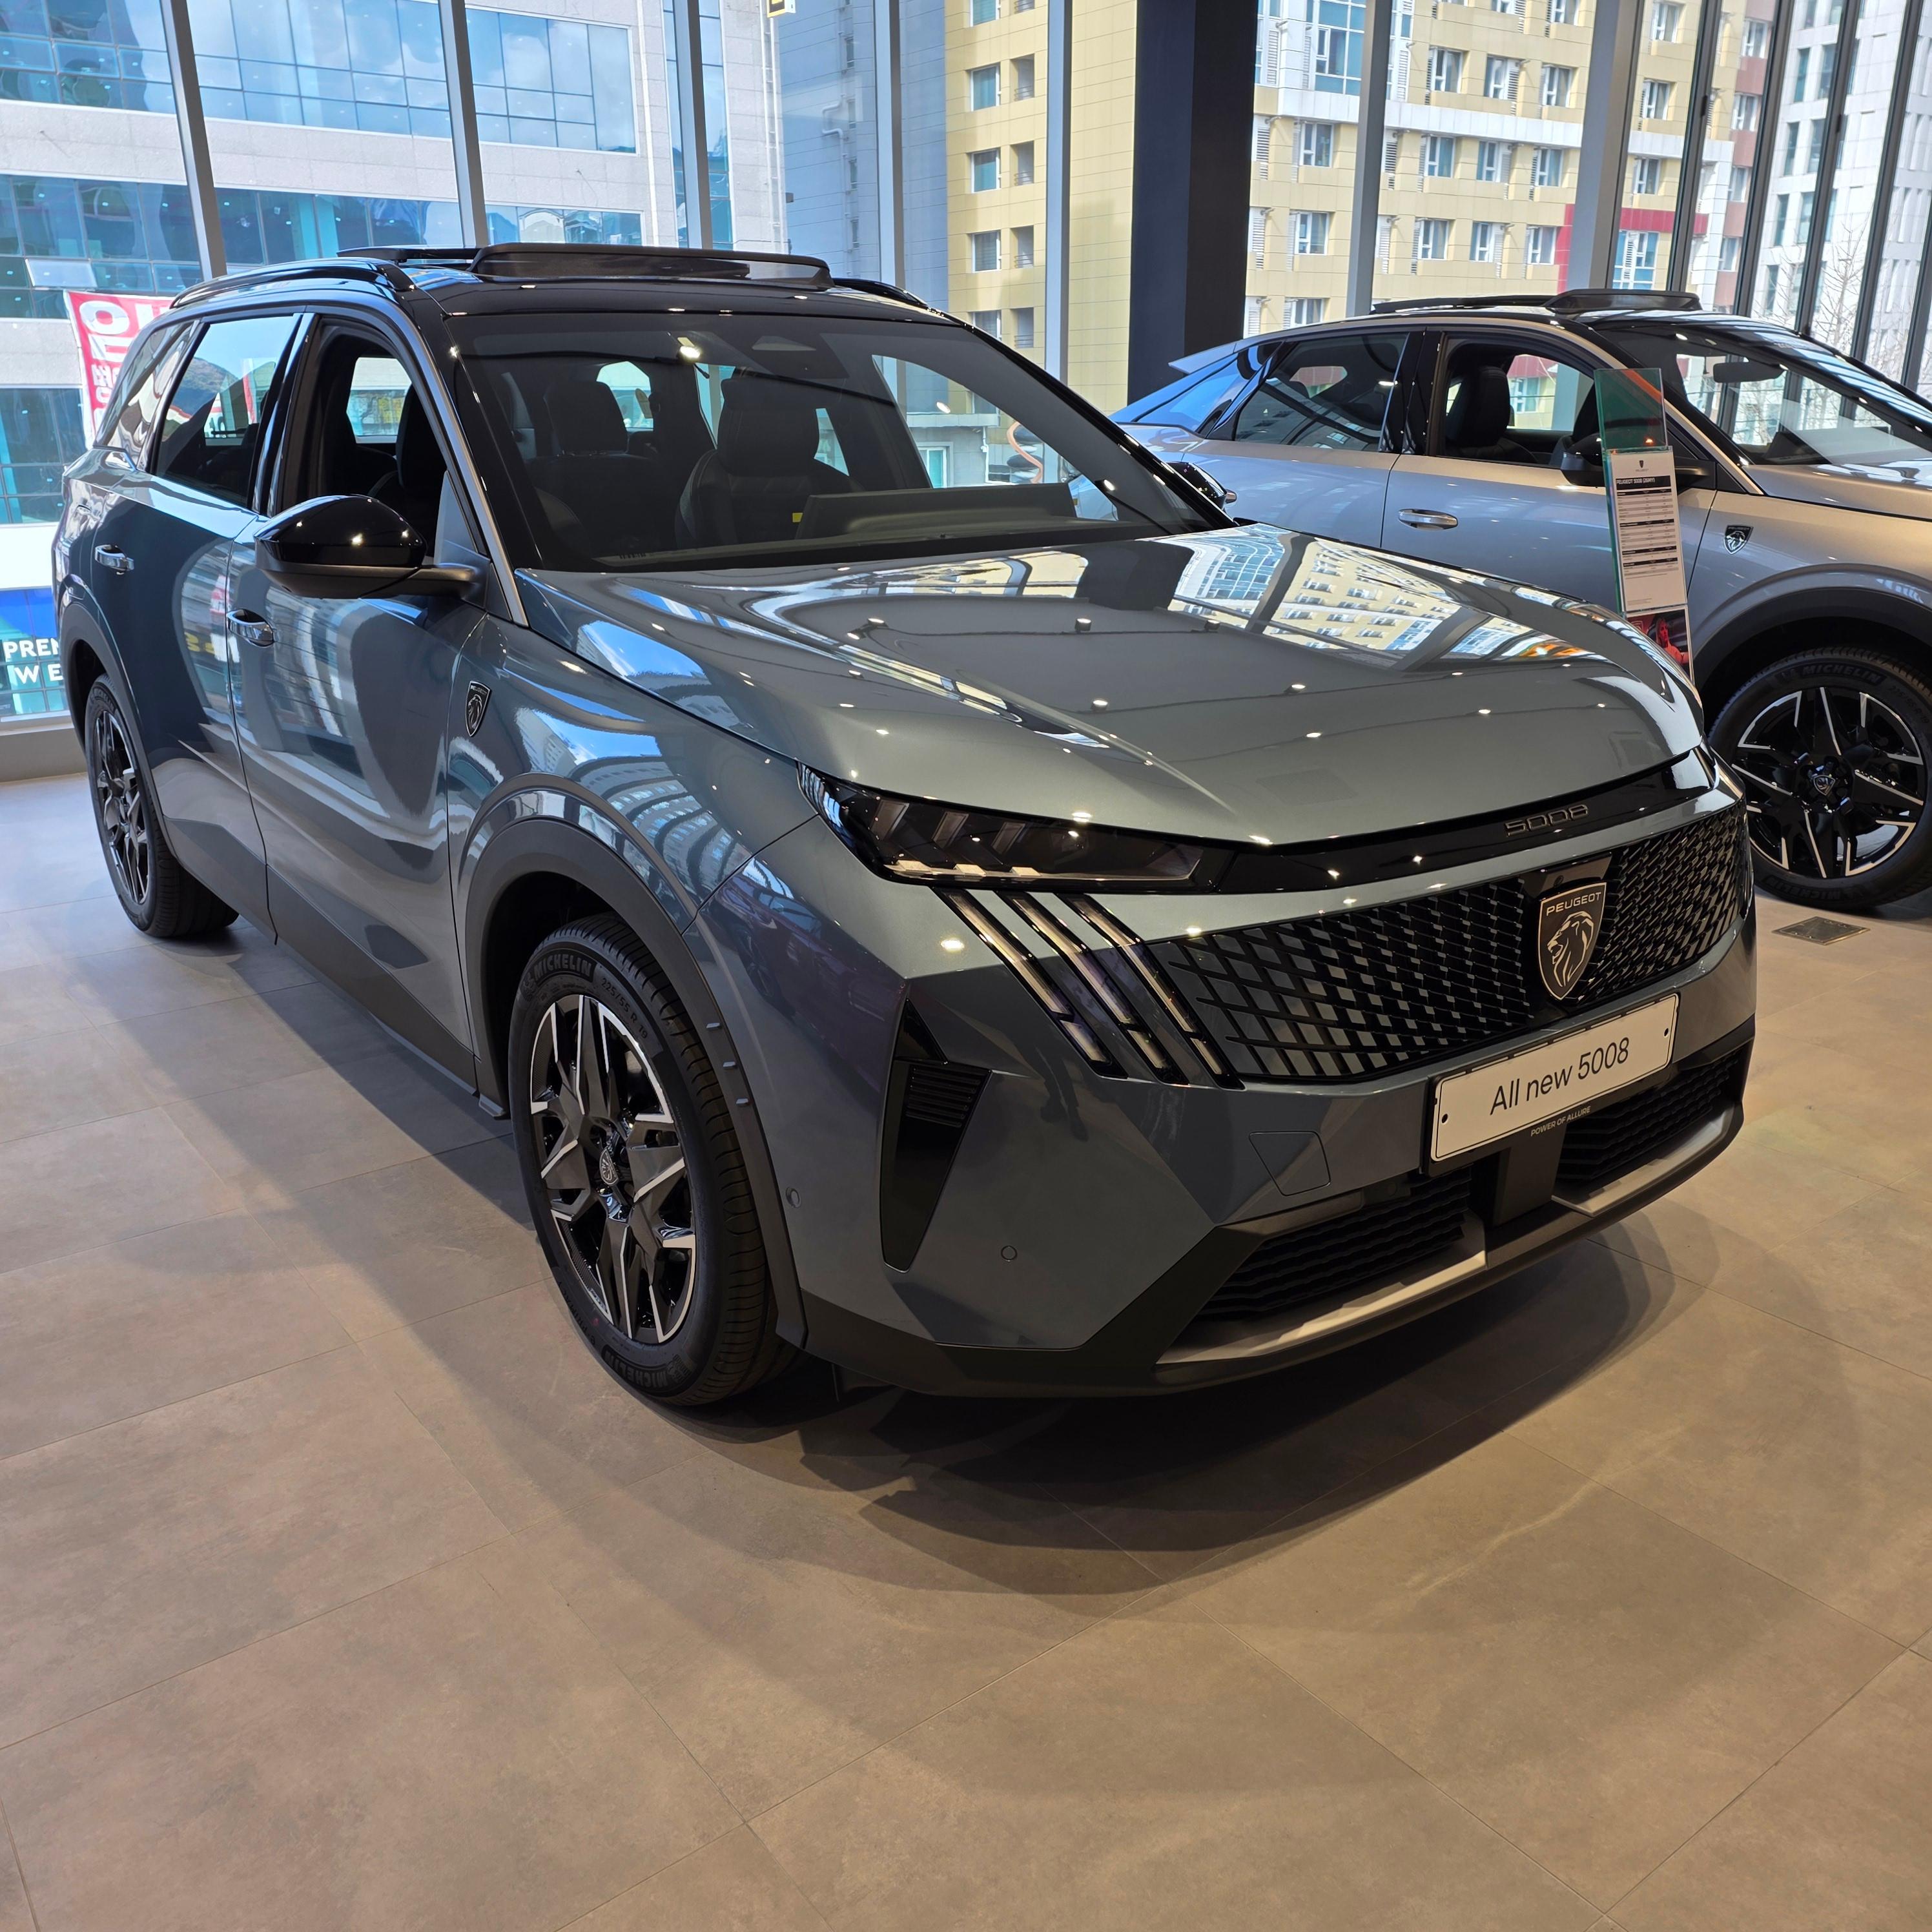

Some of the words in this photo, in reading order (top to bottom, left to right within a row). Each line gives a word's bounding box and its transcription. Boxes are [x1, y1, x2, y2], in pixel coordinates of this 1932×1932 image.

[1802, 664, 1882, 683] MICHELIN
[1505, 805, 1588, 837] 5008
[1546, 892, 1601, 916] PEUGEOT
[534, 954, 592, 978] MICHELIN
[601, 977, 630, 1012] 225/55
[630, 1012, 639, 1023] R
[639, 1023, 649, 1039] 19
[1490, 1078, 1520, 1116] All
[1526, 1065, 1573, 1102] new
[1577, 1036, 1630, 1080] 5008
[1530, 1120, 1556, 1136] POWER
[1557, 1117, 1566, 1126] OF
[1566, 1105, 1591, 1122] ALLURE
[604, 1351, 669, 1388] MICHELIN
